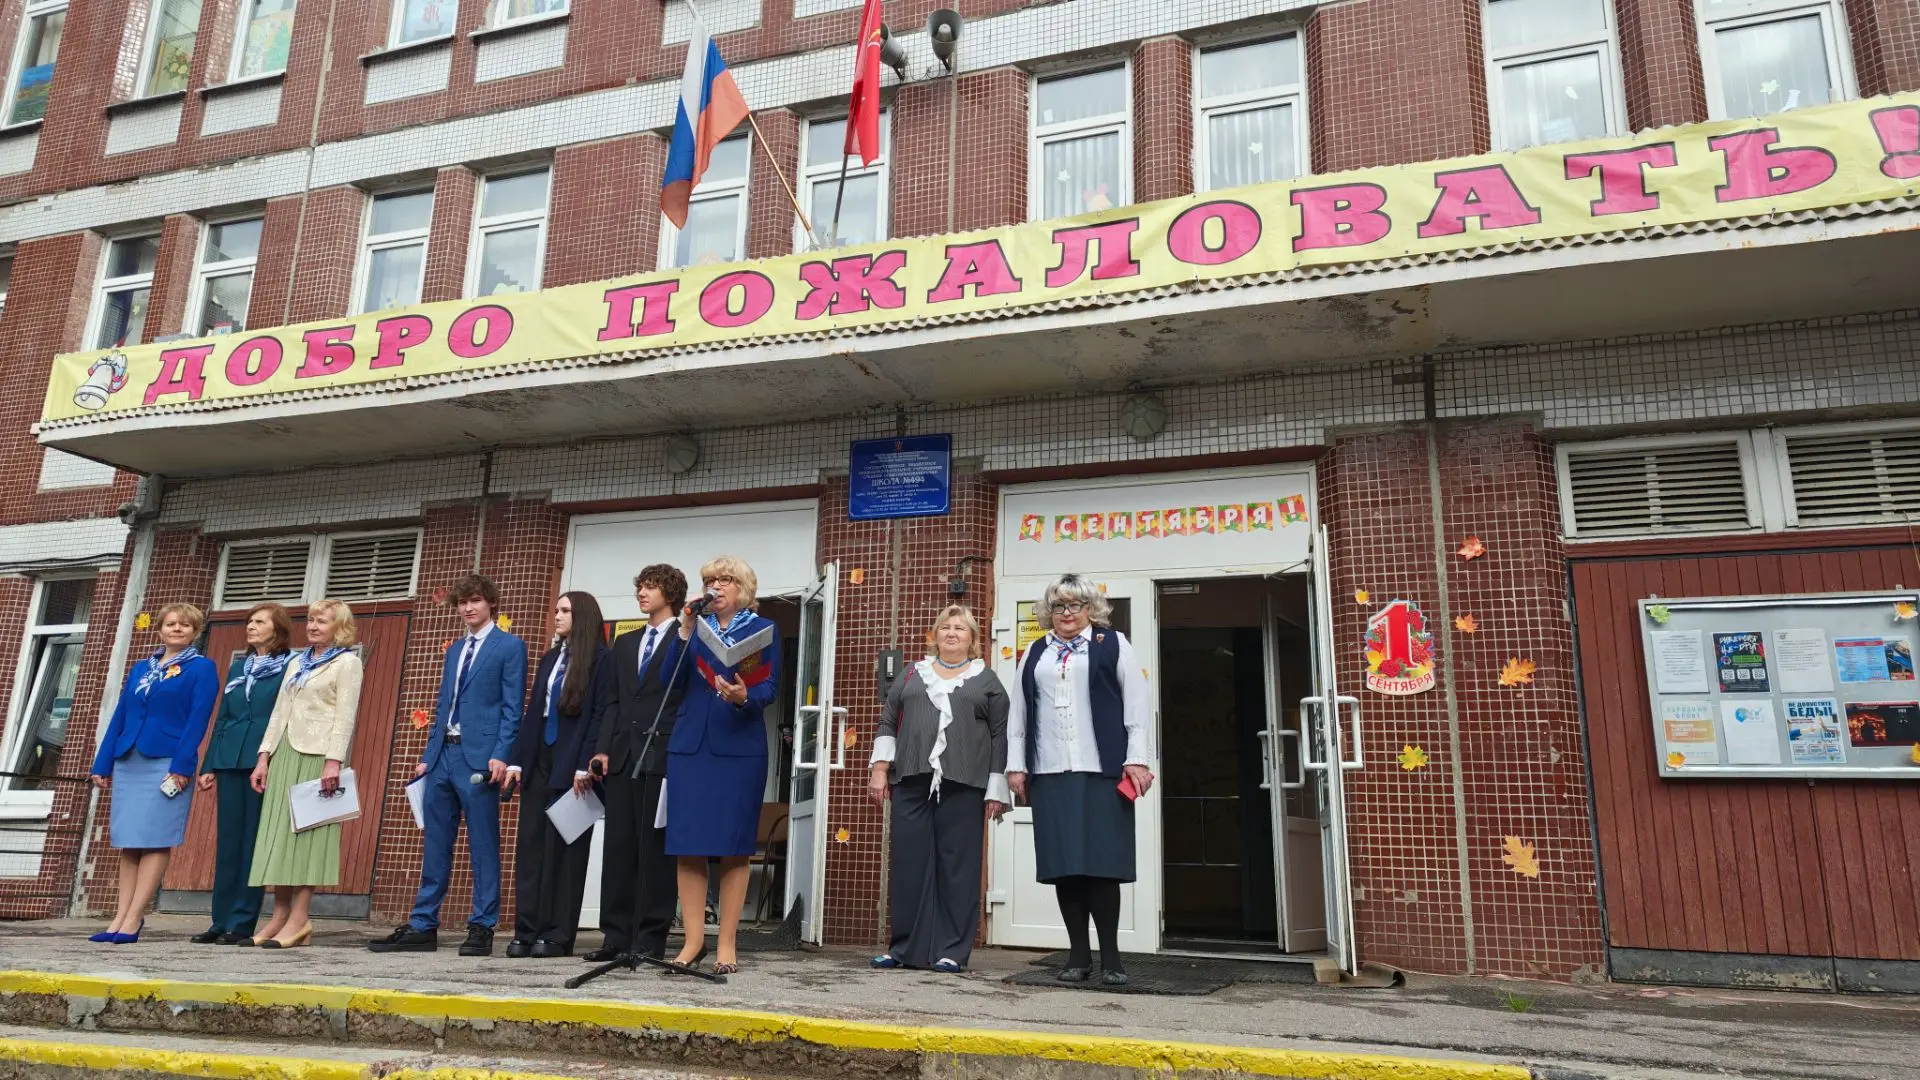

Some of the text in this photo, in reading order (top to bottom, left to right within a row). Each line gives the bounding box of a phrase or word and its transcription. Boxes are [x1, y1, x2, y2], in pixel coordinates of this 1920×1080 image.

[143, 105, 1920, 404] ДОБРО ПОЖАЛОВАТЬ!
[1026, 518, 1038, 536] 1
[1369, 602, 1419, 669] 1
[1368, 672, 1433, 692] СЕНТЯБРЯ
